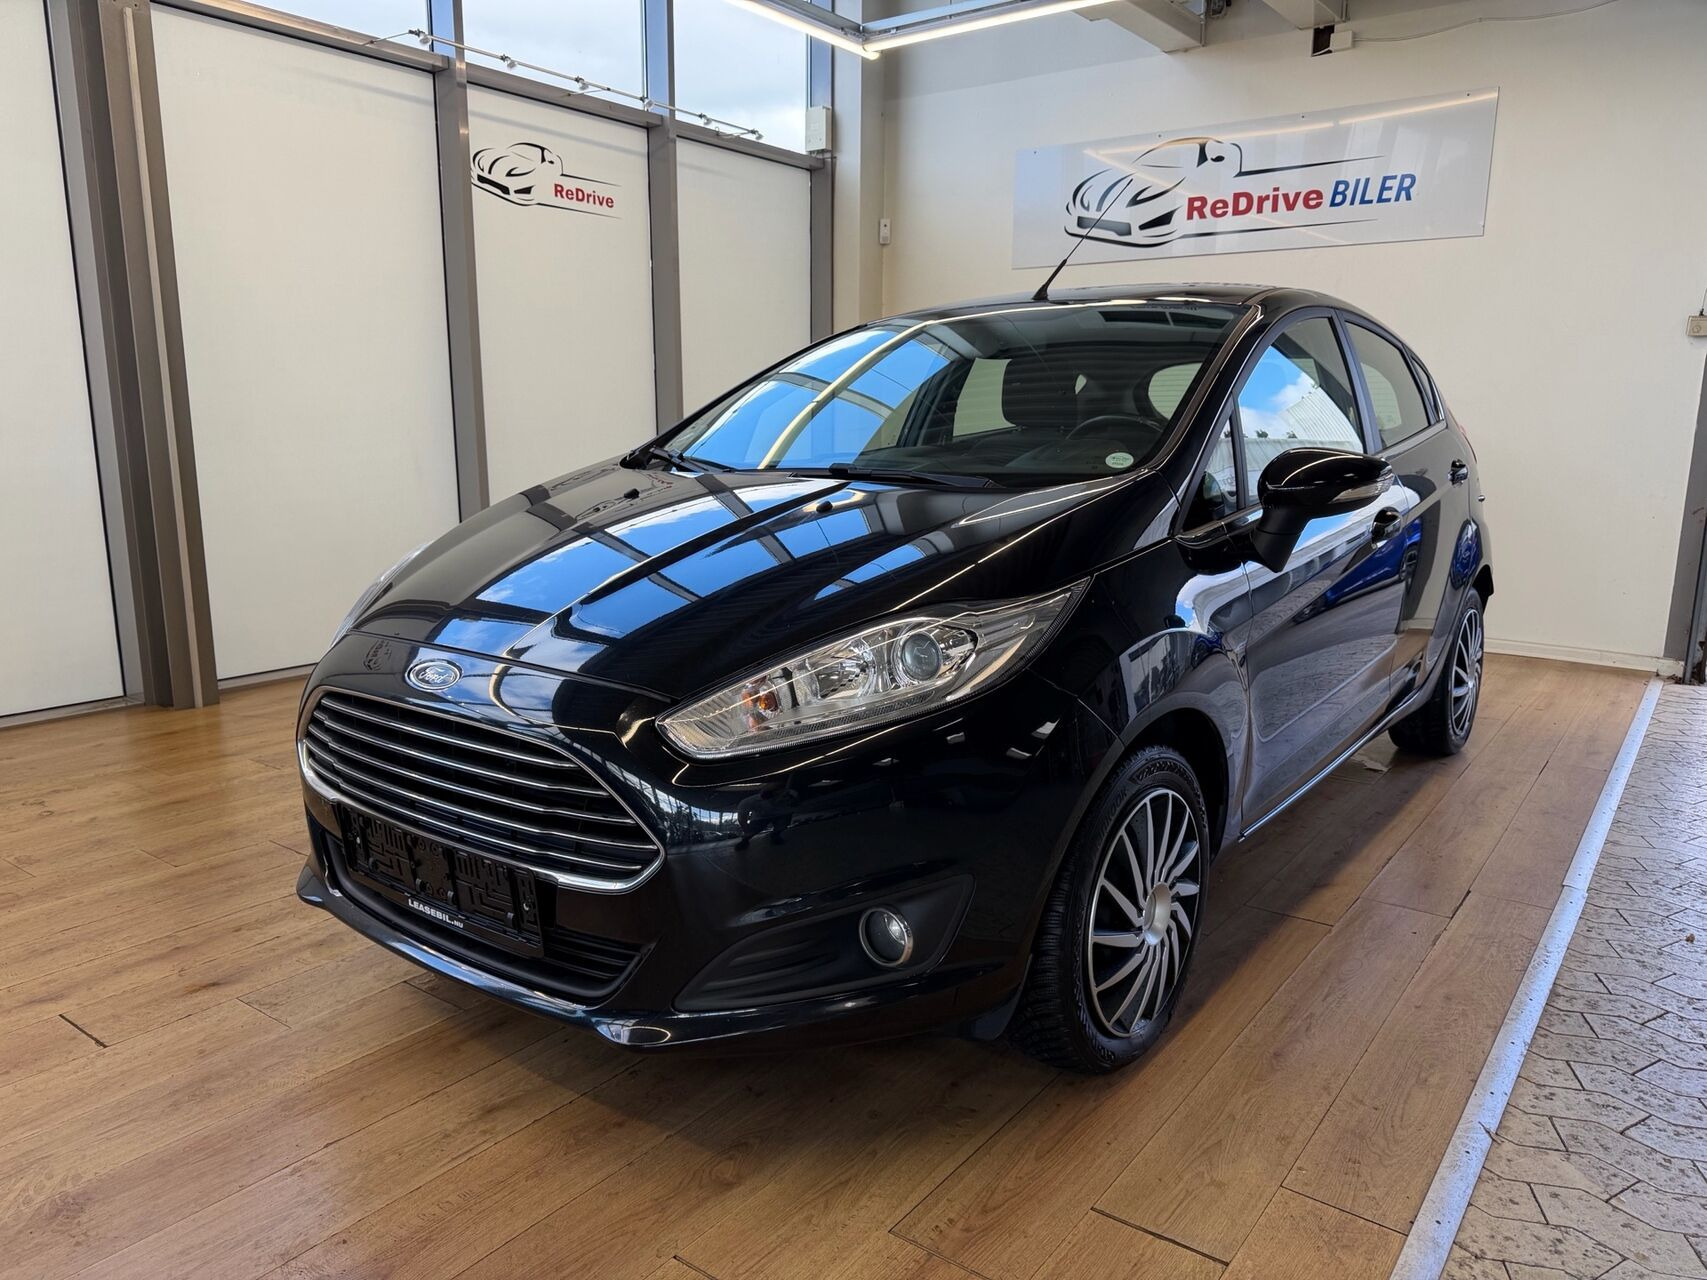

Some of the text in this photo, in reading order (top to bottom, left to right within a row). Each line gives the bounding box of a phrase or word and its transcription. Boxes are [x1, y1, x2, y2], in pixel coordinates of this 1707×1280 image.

[554, 183, 615, 208] ReDrive
[1186, 173, 1417, 220] ReDrive BILER
[418, 665, 449, 684] Ford
